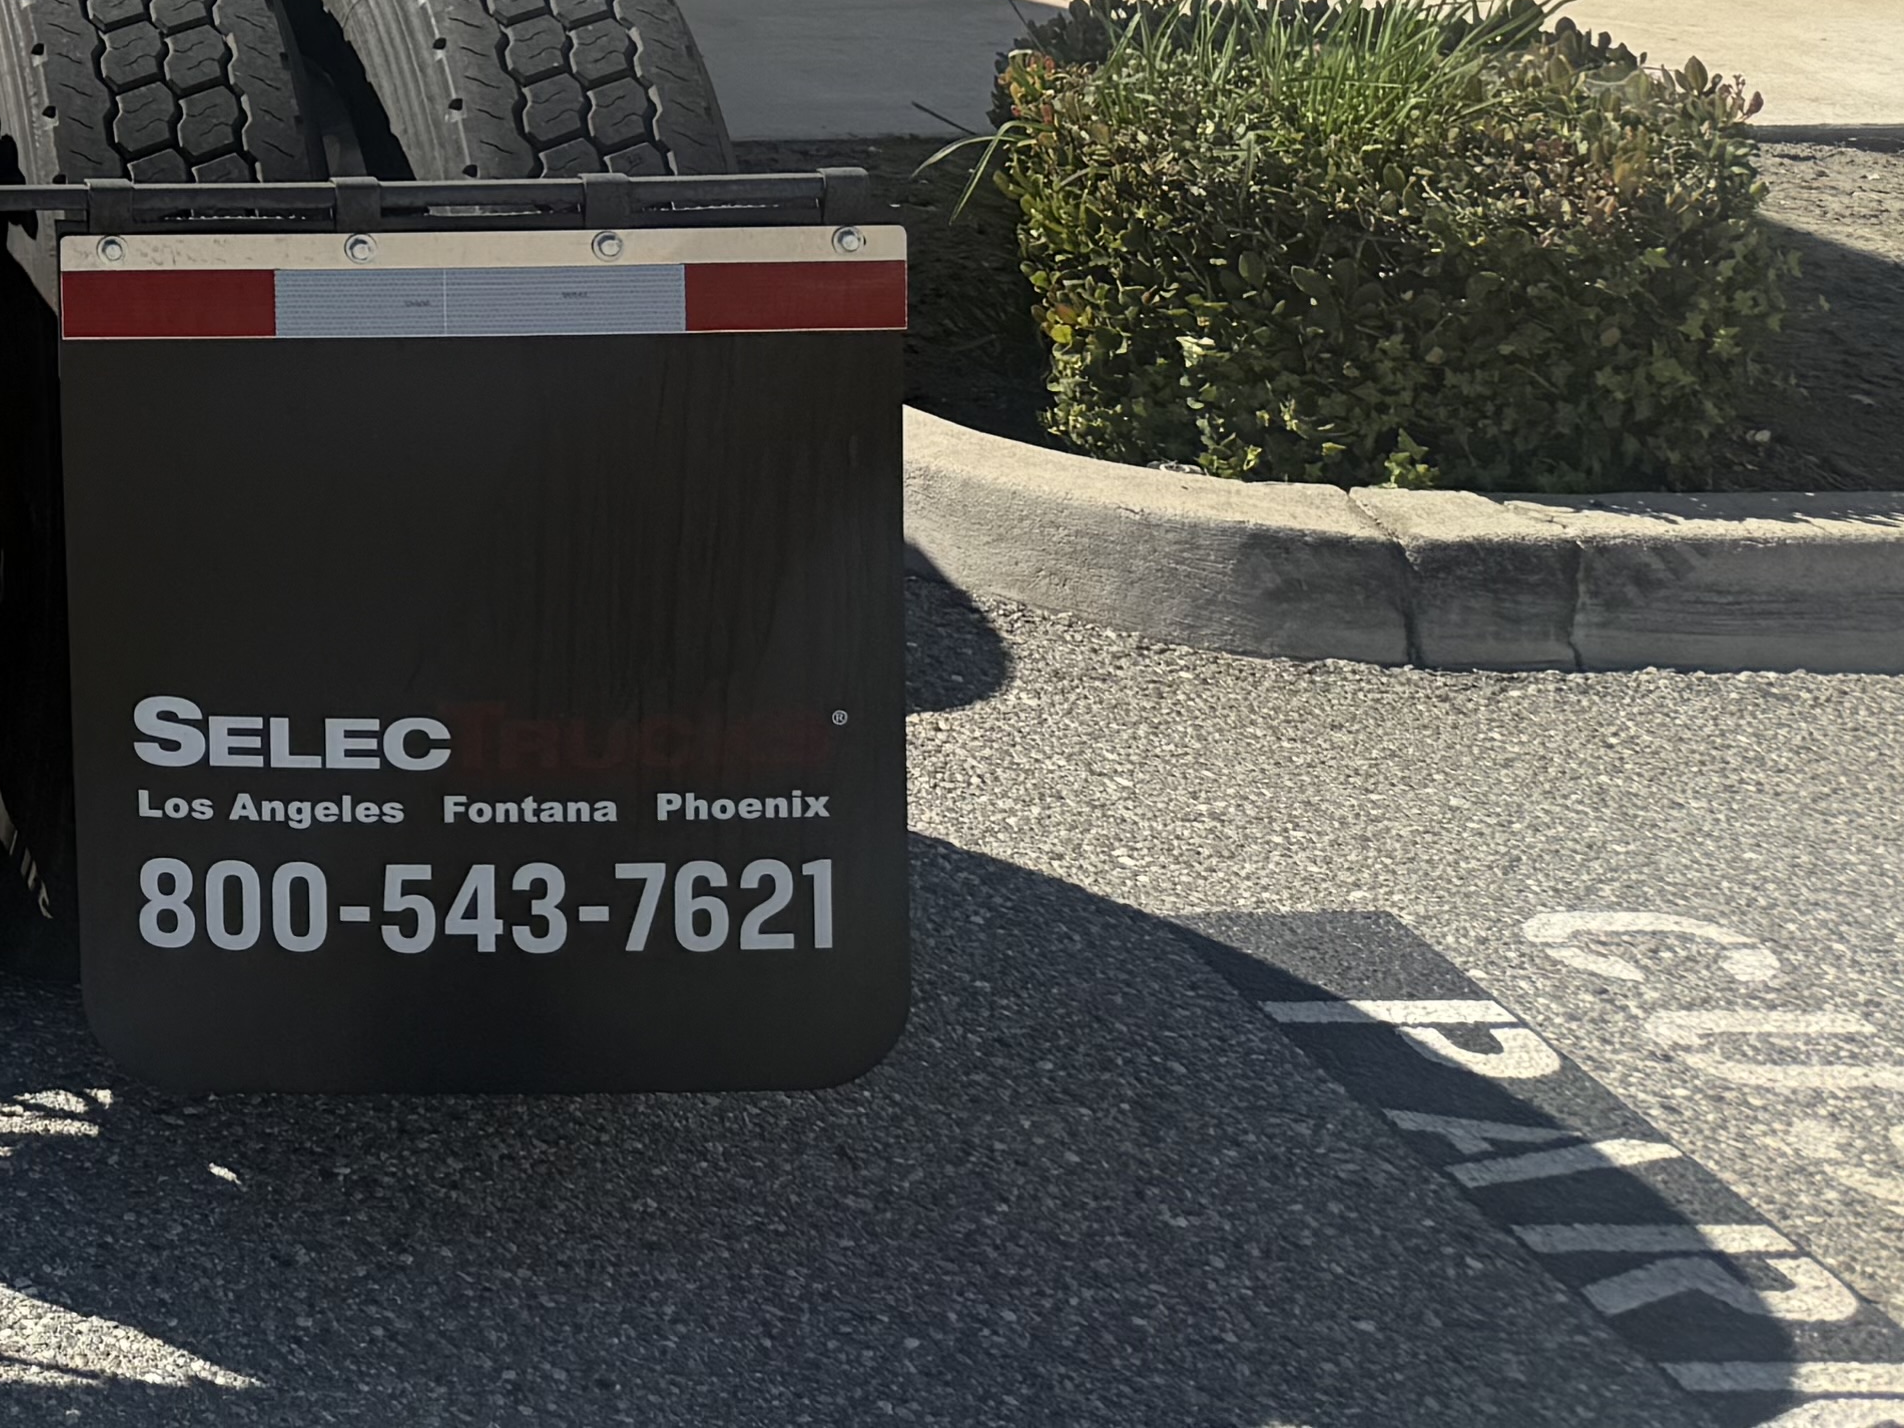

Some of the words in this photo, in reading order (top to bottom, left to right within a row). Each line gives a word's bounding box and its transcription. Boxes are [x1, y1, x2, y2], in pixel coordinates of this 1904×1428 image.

[139, 790, 213, 819] Los
[230, 794, 404, 829] Angeles
[444, 796, 617, 823] Fontana
[657, 790, 830, 820] Phoenix
[140, 858, 832, 953] 800-543-7621
